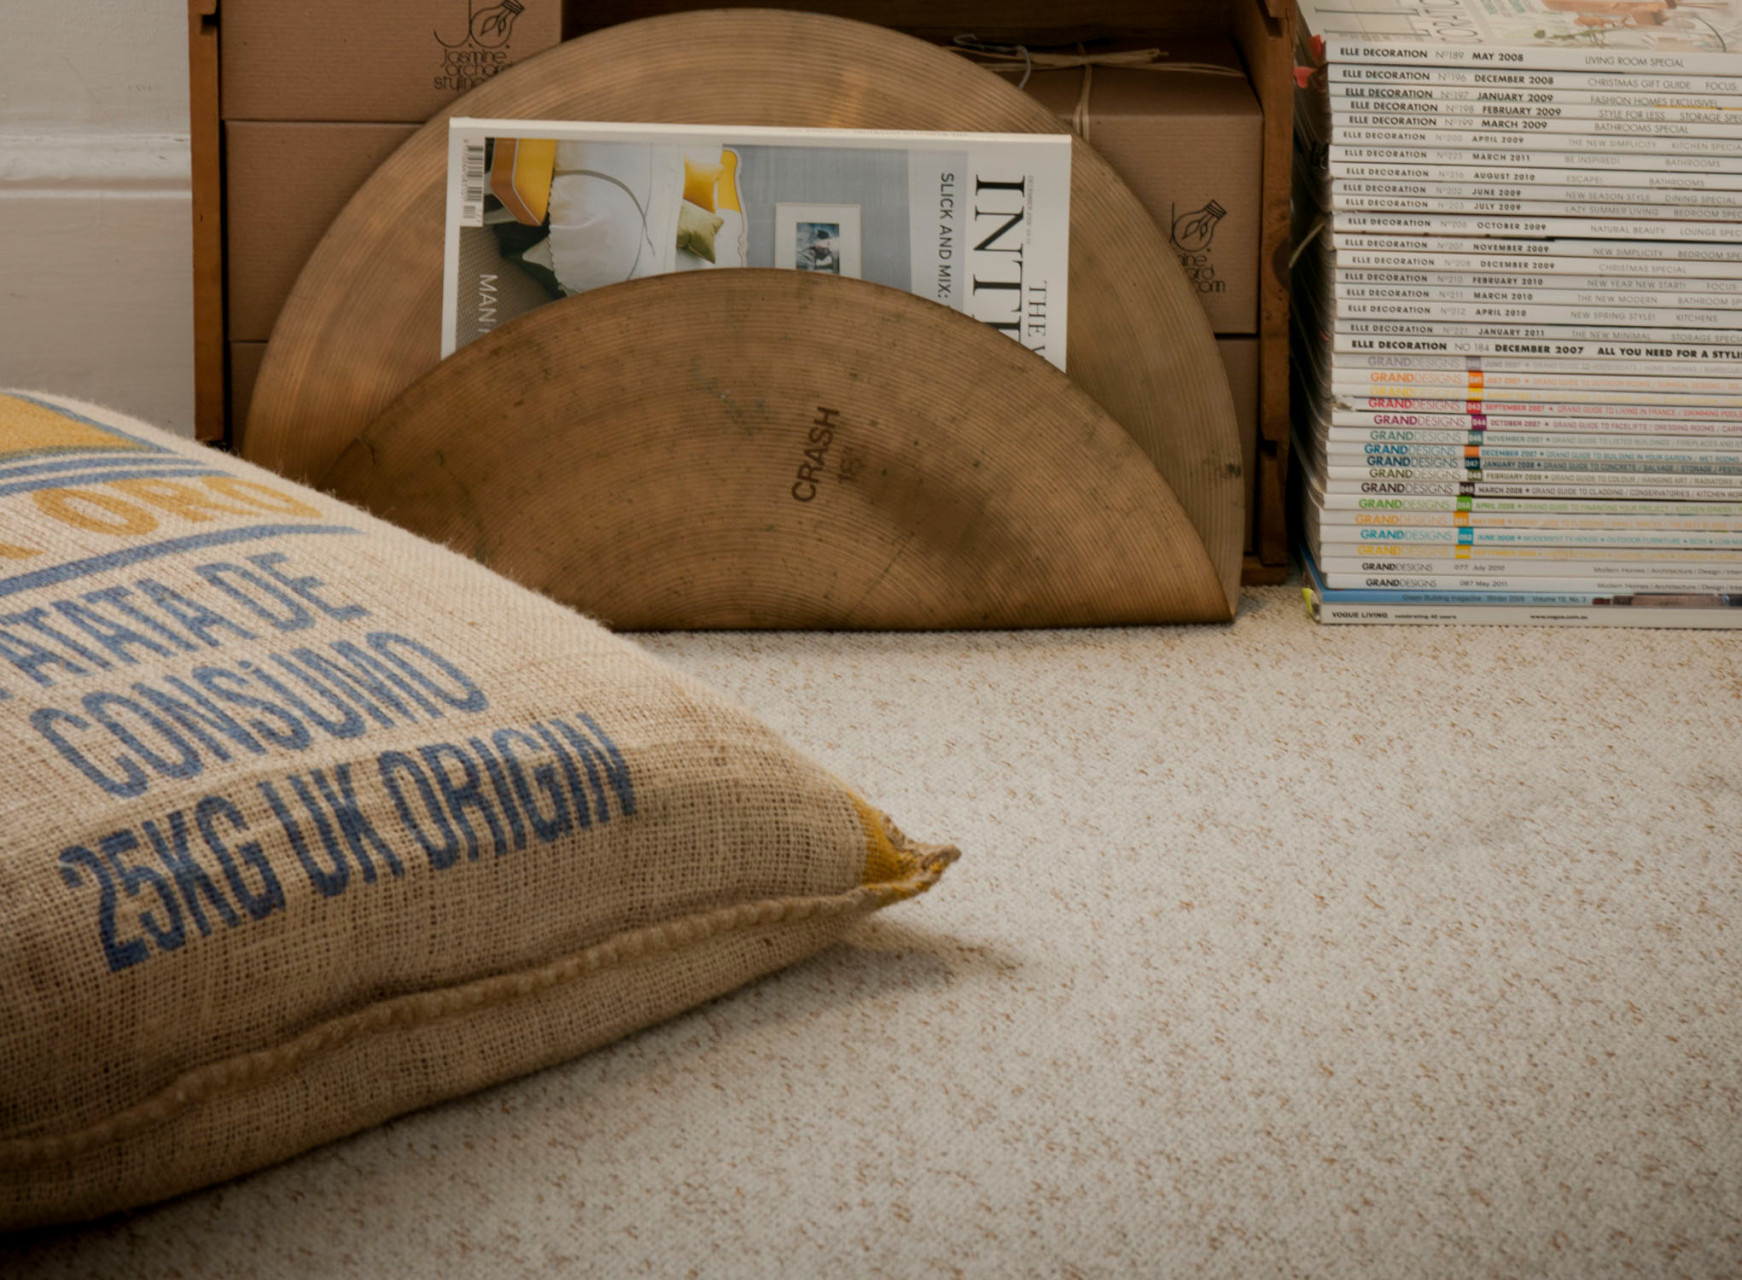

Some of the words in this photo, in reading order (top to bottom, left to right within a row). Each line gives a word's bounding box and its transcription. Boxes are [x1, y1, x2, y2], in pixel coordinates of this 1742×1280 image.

[1340, 48, 1359, 57] ELLE
[1363, 48, 1428, 58] DECORATION
[1472, 53, 1494, 61] MAY
[1499, 53, 1524, 62] 2008
[1585, 56, 1615, 65] LIVING
[1618, 57, 1648, 66] ROOM
[1650, 58, 1684, 68] SPECIAL
[1342, 70, 1362, 78] ELLE
[1366, 71, 1430, 80] DECORATION
[1474, 74, 1525, 84] DECEMBER
[1529, 76, 1554, 85] 2008
[1588, 79, 1639, 88] CHRISTMAS
[1641, 80, 1660, 88] GIFT
[1663, 81, 1691, 90] GUIDE
[1345, 88, 1364, 97] ELLE
[1369, 89, 1433, 99] DECORATION
[1477, 92, 1523, 101] JANUARY
[1528, 93, 1553, 102] 2009
[1590, 96, 1632, 105] FASHION
[1634, 97, 1667, 106] HOMES
[1351, 102, 1369, 110] ELLE
[1373, 102, 1438, 112] DECORATION
[1482, 106, 1531, 115] FEBRUARY
[1536, 108, 1561, 117] 2009
[1599, 110, 1622, 118] STYLE
[1625, 111, 1643, 119] FOR
[1646, 112, 1666, 120] LESS
[1680, 112, 1720, 122] STORAGE
[1350, 116, 1368, 124] ELLE
[1372, 117, 1437, 126] DECORATION
[1482, 120, 1518, 128] MARCH
[1522, 121, 1547, 129] 2009
[1594, 123, 1652, 132] BATHROOMS
[1654, 125, 1689, 134] SPECIAL
[1365, 132, 1426, 141] DECORATION
[1472, 135, 1498, 143] APRIL
[1501, 136, 1524, 144] 2009
[1344, 149, 1362, 157] ELLE
[1367, 150, 1427, 159] DECORATION
[1472, 152, 1506, 161] MARCH
[1510, 153, 1530, 162] 2011
[1665, 158, 1720, 167] BATHROOMS
[1368, 168, 1429, 177] DECORATION
[1474, 172, 1510, 180] AUGUST
[1514, 173, 1535, 181] 2010
[939, 173, 955, 220] SLICK
[1343, 184, 1361, 192] ELLE
[1365, 185, 1427, 194] DECORATION
[1472, 188, 1495, 196] JUNE
[1499, 189, 1521, 197] 2009
[1665, 194, 1698, 203] DINING
[1701, 195, 1736, 205] SPECIAL
[1368, 199, 1428, 208] DECORATION
[1474, 202, 1494, 210] JULY
[1499, 203, 1521, 211] 2009
[1673, 209, 1719, 218] BEDROOM
[1348, 218, 1366, 226] ELLE
[1370, 219, 1431, 228] DECORATION
[1477, 222, 1520, 230] OCTOBER
[1524, 223, 1546, 231] 2009
[938, 224, 952, 261] AND
[1367, 240, 1428, 249] DECORATION
[1473, 243, 1522, 251] NOVEMBER
[1616, 248, 1663, 257] SIMPLICITY
[1678, 250, 1723, 259] BEDROOM
[1374, 257, 1434, 266] DECORATION
[1480, 261, 1528, 269] DECEMBER
[1367, 273, 1427, 282] DECORATION
[1472, 276, 1517, 284] FEBRUARY
[1368, 289, 1429, 298] DECORATION
[1473, 291, 1508, 299] MARCH
[1678, 297, 1728, 305] BATHROOM
[1028, 281, 1048, 337] THE
[1348, 304, 1366, 312] ELLE
[1370, 305, 1431, 314] DECORATION
[1475, 308, 1500, 316] APRIL
[1505, 309, 1527, 317] 2010
[1676, 313, 1718, 322] KITCHENS
[1372, 325, 1433, 333] DECORATION
[1478, 327, 1520, 335] JANUARY
[1525, 328, 1545, 336] 2011
[1351, 340, 1374, 348] ELLE
[1378, 340, 1447, 350] DECORATION
[1494, 344, 1550, 353] DECEMBER
[1555, 346, 1584, 355] 2007
[1597, 348, 1616, 356] ALL
[1619, 348, 1642, 357] YOU
[1645, 349, 1673, 357] NEED
[1677, 349, 1697, 358] FOR
[1701, 350, 1709, 358] A
[791, 406, 840, 502] CRASH
[0, 578, 258, 700] ATATA
[195, 552, 374, 631] DE
[29, 631, 487, 798] CONSUMO
[59, 796, 287, 972] 25KG
[256, 763, 403, 897] UK
[377, 711, 637, 870] ORIGIN
